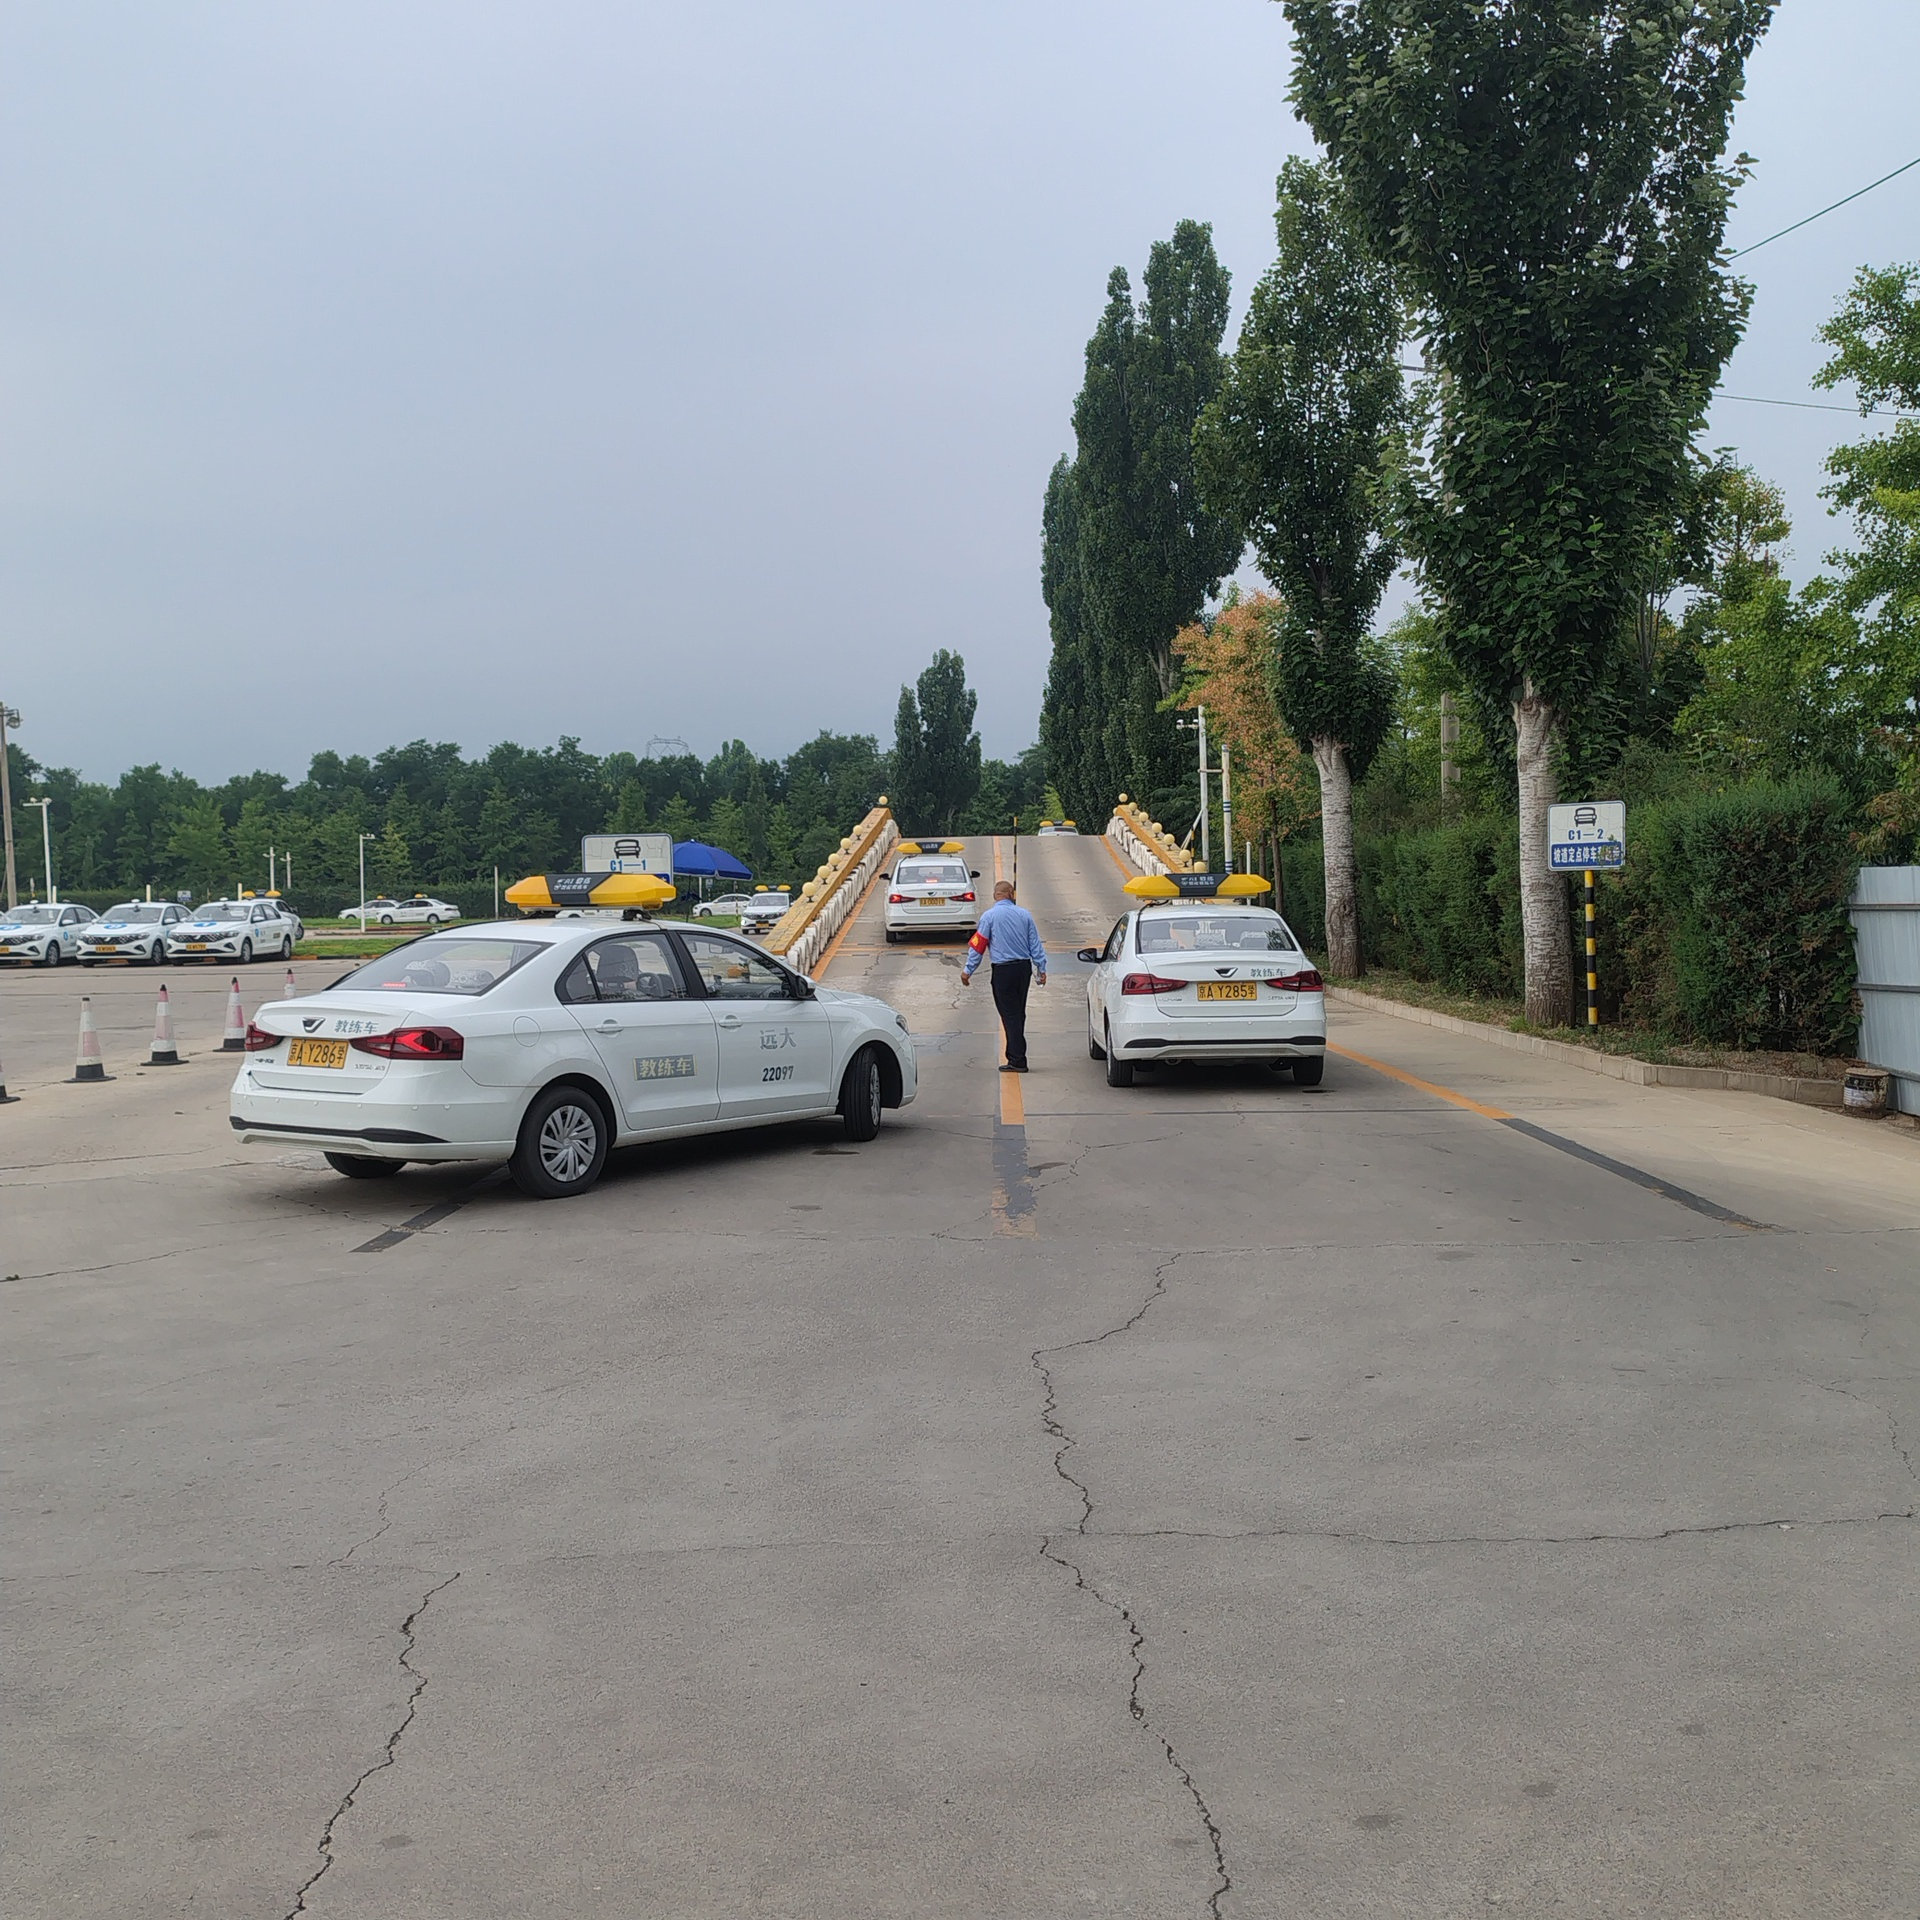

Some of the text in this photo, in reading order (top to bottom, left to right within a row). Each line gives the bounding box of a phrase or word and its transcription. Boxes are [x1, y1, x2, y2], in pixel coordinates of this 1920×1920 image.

[1250, 968, 1287, 977] 教练车
[334, 1020, 379, 1034] 教练车
[760, 1027, 797, 1050] 远大
[639, 1057, 693, 1077] 教练车
[762, 1065, 794, 1082] 22097
